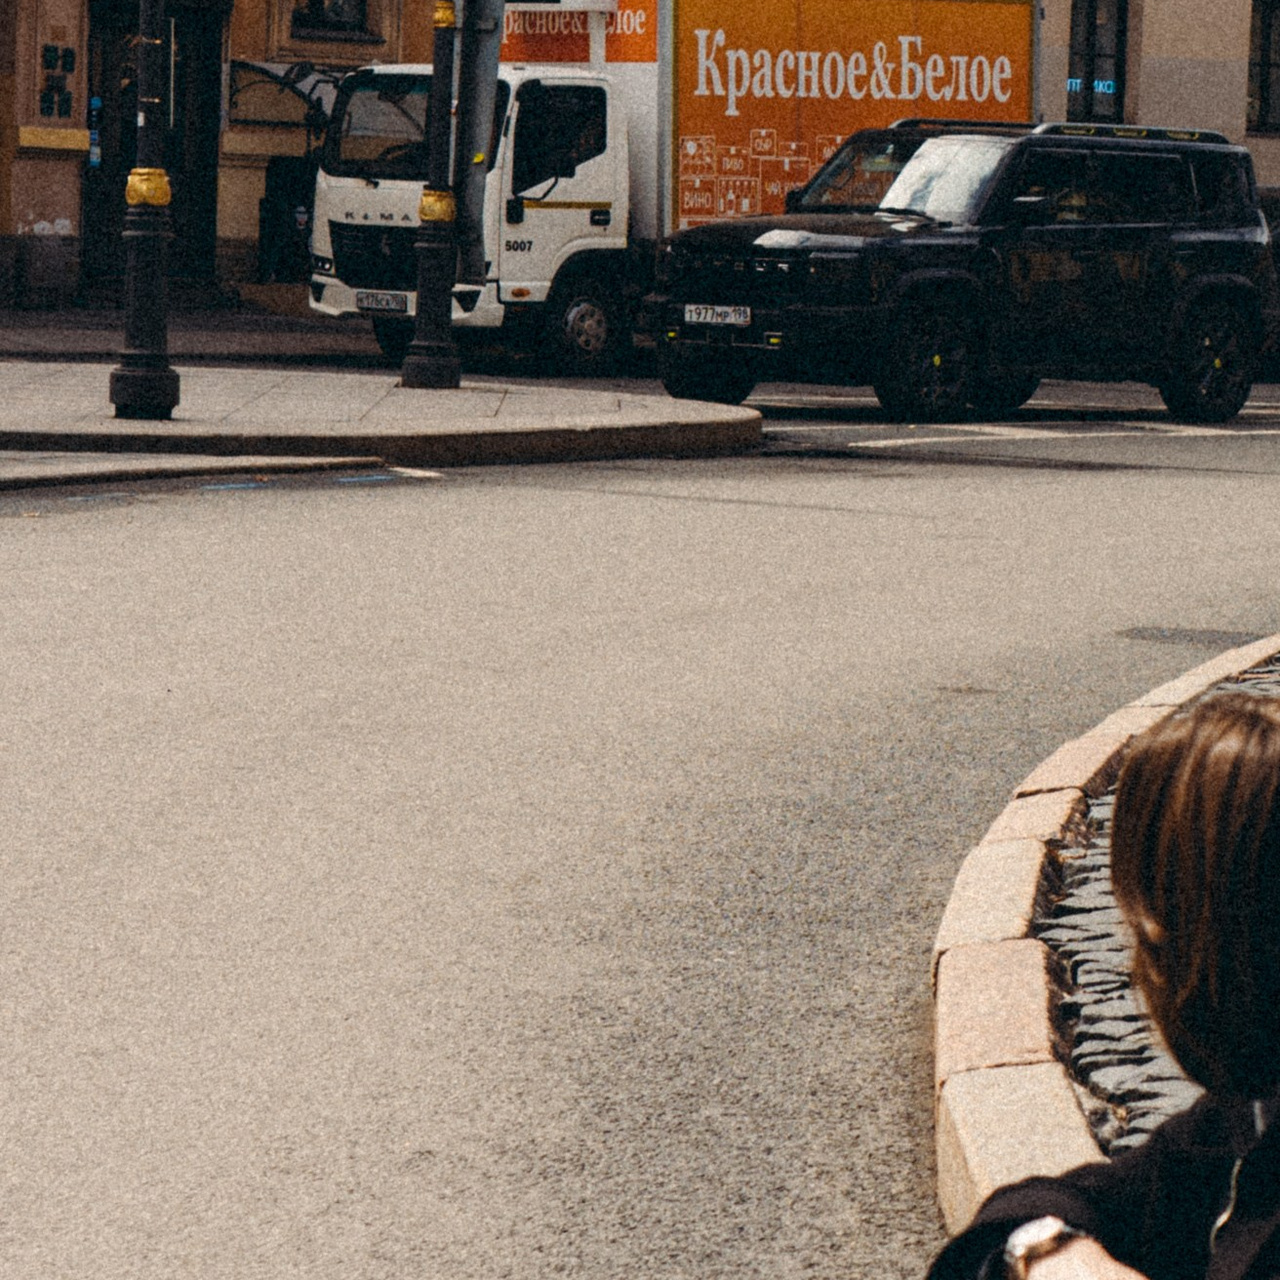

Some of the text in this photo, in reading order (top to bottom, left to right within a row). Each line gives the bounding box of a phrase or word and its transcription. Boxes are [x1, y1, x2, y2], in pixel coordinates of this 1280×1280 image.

[694, 29, 1012, 116] Красное&Белое
[684, 192, 712, 209] ВИНО
[505, 240, 533, 252] 5007
